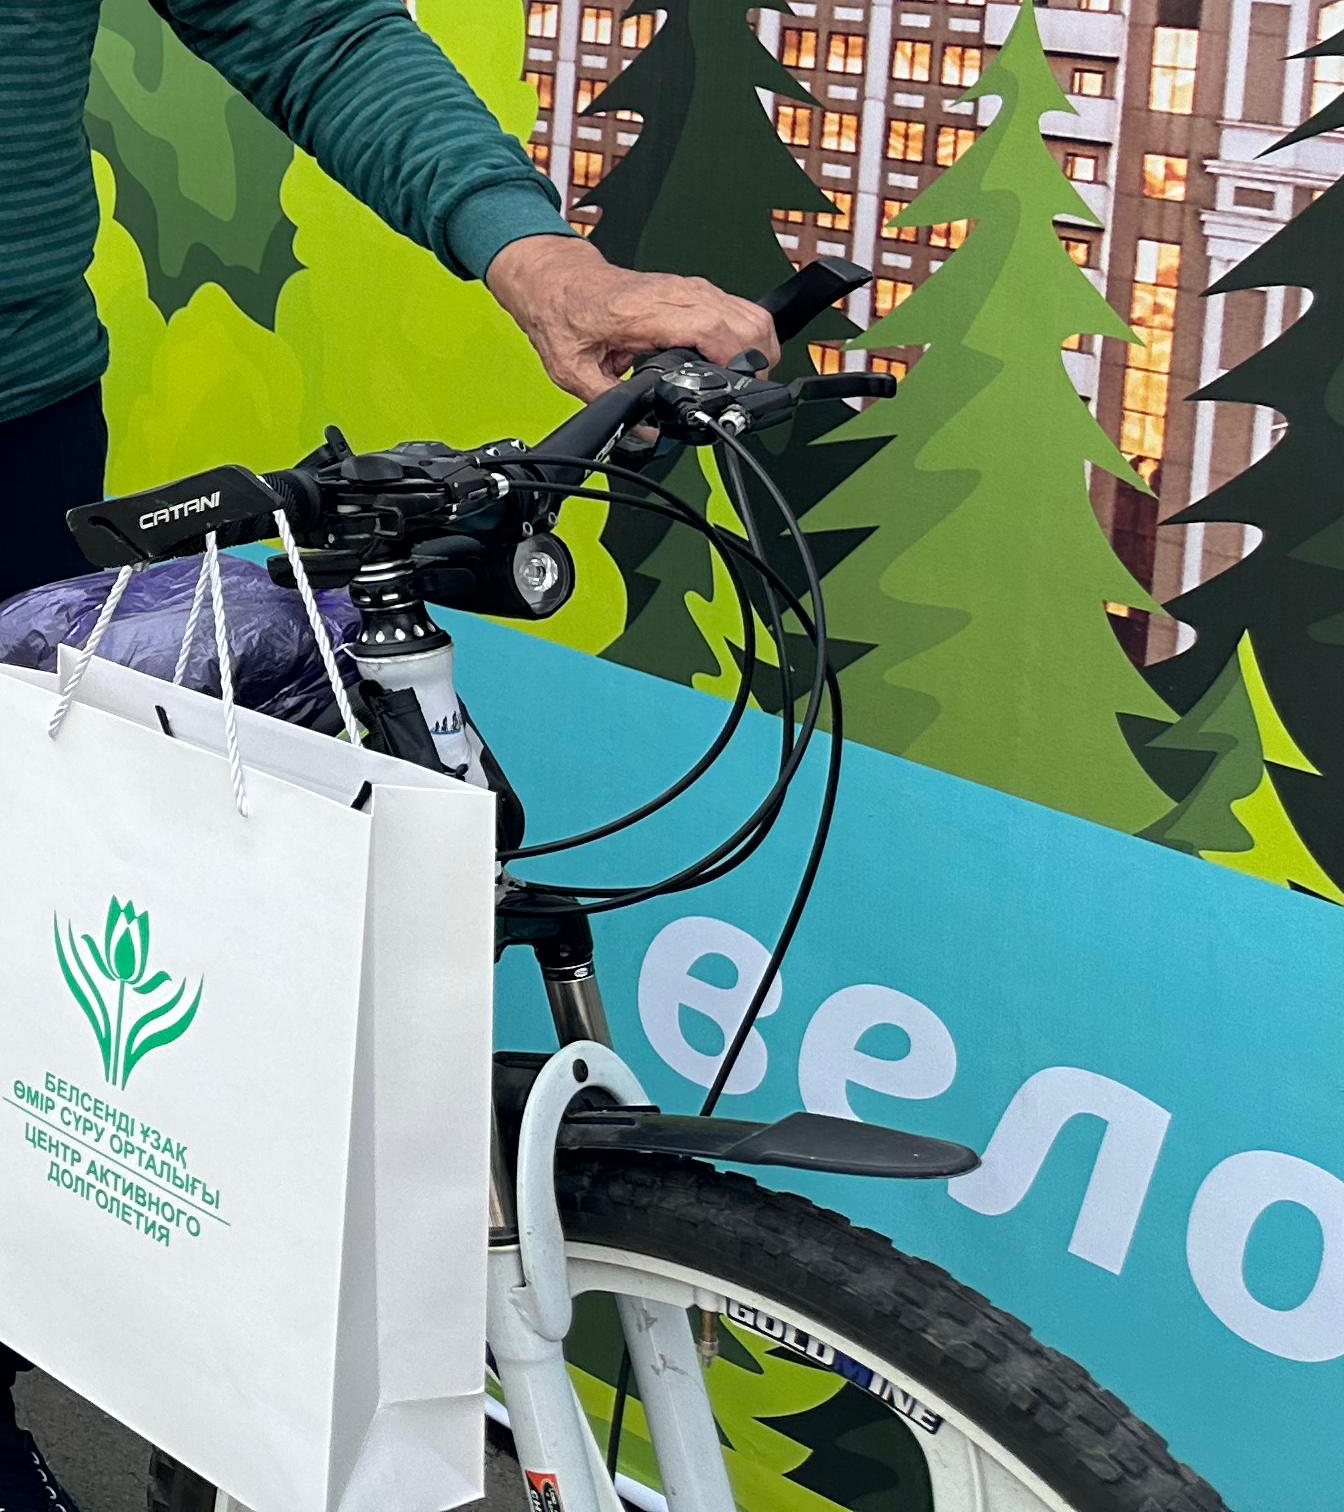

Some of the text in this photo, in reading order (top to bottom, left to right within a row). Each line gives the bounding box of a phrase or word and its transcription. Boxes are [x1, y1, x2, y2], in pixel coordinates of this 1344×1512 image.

[138, 490, 222, 530] CATANI
[12, 1079, 221, 1210] ӨМІР СҮРУ ОРТАЛЫҒЫ
[44, 1071, 188, 1170] БЕЛСЕНДІ ҰЗАҚ
[24, 1121, 201, 1238] ЦЕНТР АКТИВНОГО
[46, 1160, 171, 1248] ДОЛГОЛЕТИЯ
[727, 1298, 942, 1435] GOLDMINE
